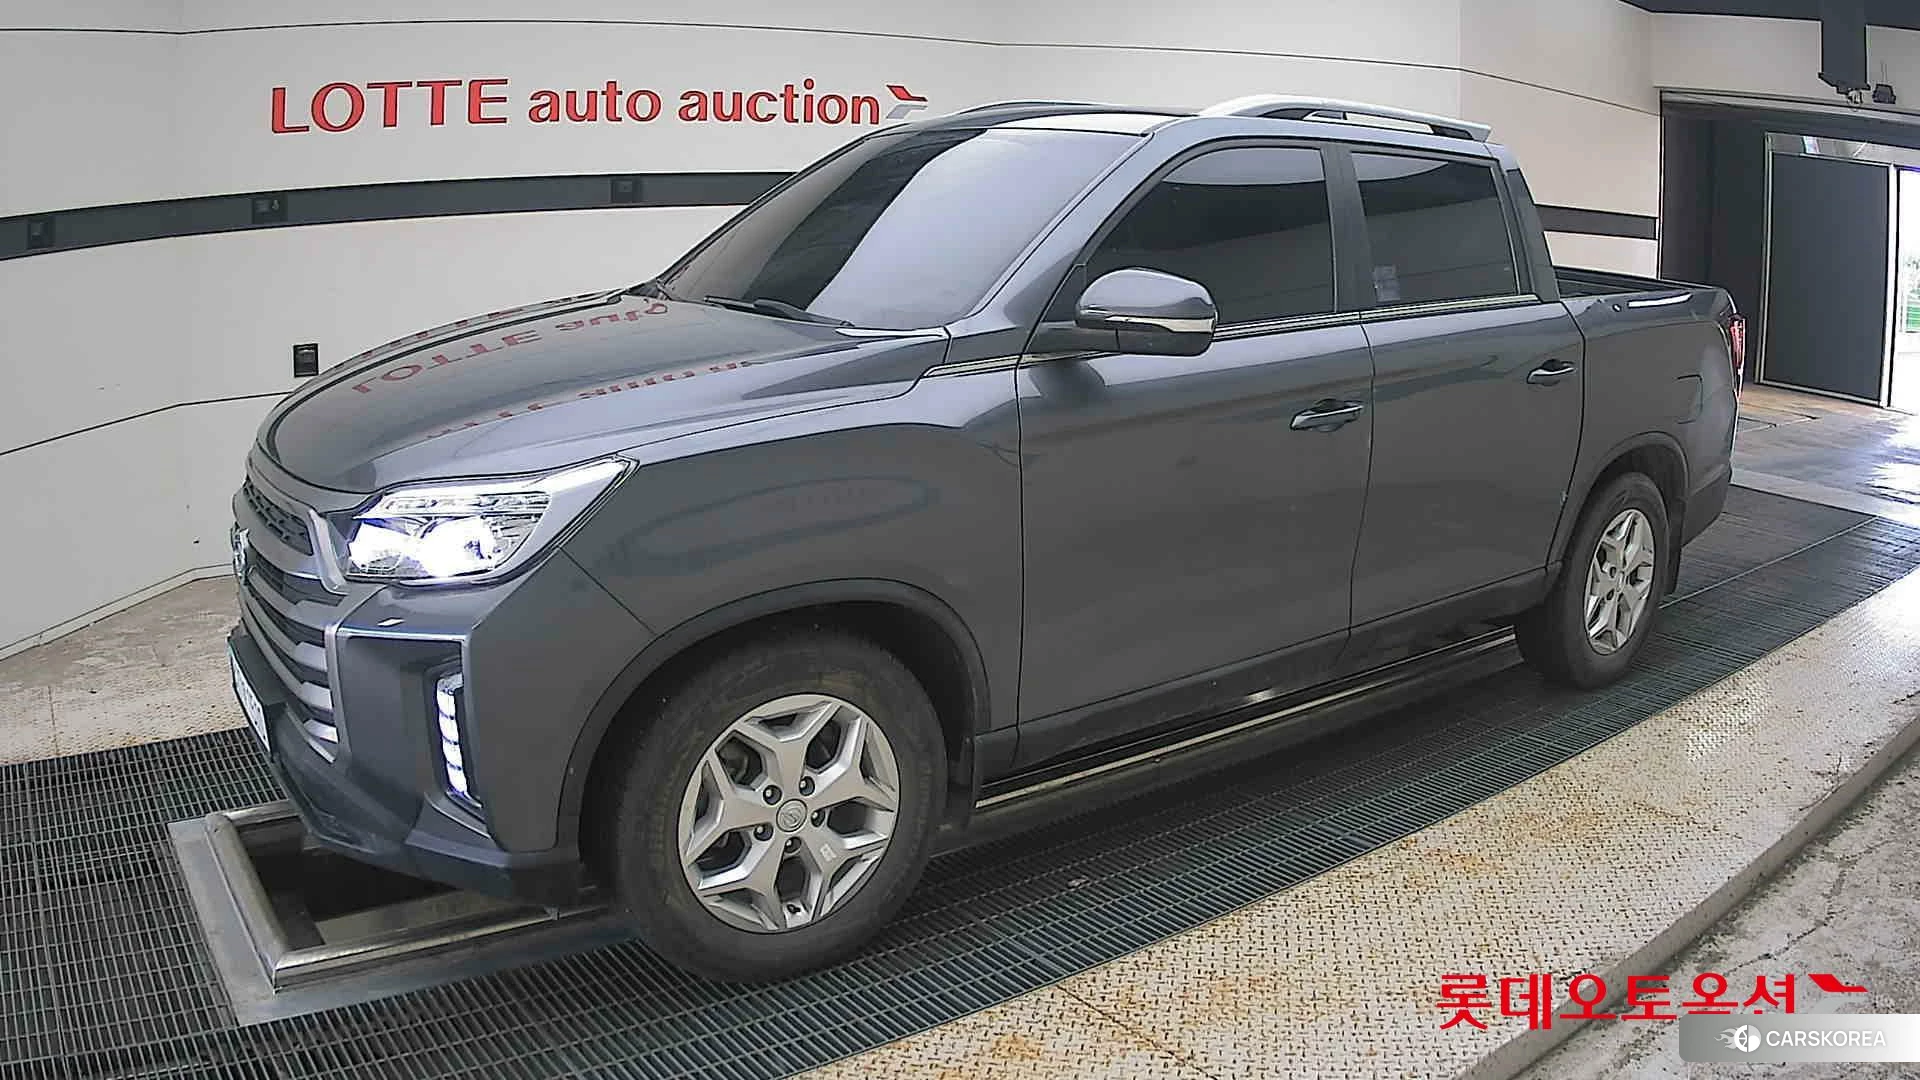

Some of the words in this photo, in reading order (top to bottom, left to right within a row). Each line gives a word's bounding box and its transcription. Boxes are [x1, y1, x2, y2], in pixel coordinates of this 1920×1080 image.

[271, 78, 508, 134] LOTTE
[527, 79, 662, 124] auto
[677, 78, 880, 125] auction
